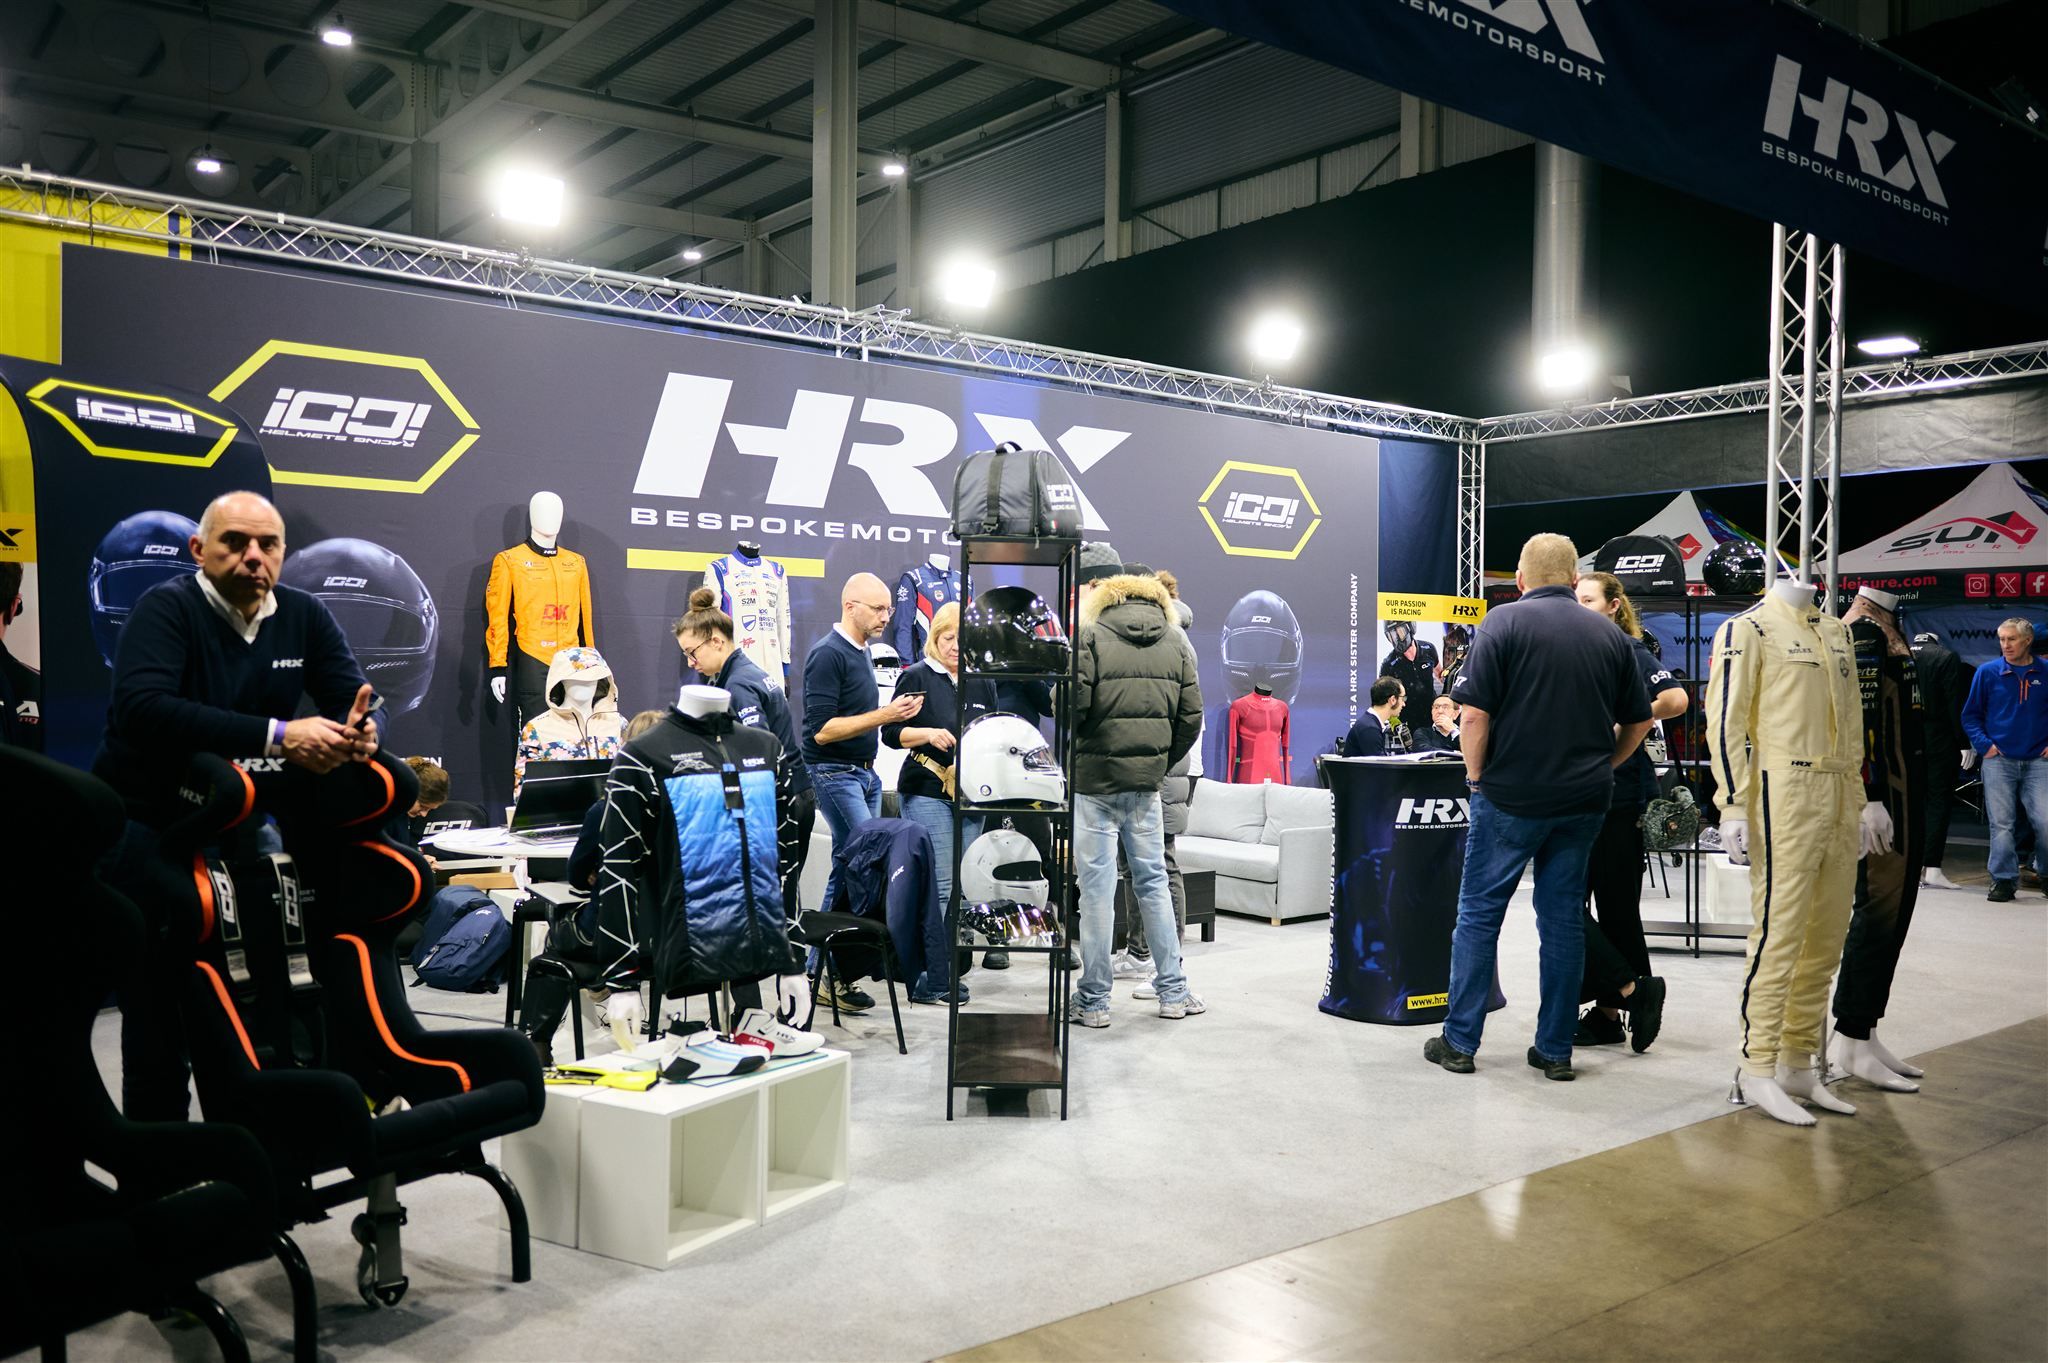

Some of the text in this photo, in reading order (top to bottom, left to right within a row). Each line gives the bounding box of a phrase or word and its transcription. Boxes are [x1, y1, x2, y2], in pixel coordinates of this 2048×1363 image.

[1400, 0, 1606, 86] EMOTORSPORT
[1763, 53, 1957, 208] HRX
[1761, 140, 1949, 226] BESPOKEMOTORSPORT
[258, 427, 348, 442] HELMETS
[633, 372, 1132, 530] HRX
[1350, 573, 1358, 627] COMPANY
[1385, 599, 1426, 608] OUR PASSION
[1398, 608, 1421, 616] RACING
[1453, 604, 1480, 617] HRX
[272, 659, 304, 669] HRX
[1350, 694, 1357, 704] A
[1350, 705, 1357, 716] IS
[1790, 759, 1813, 768] HRX
